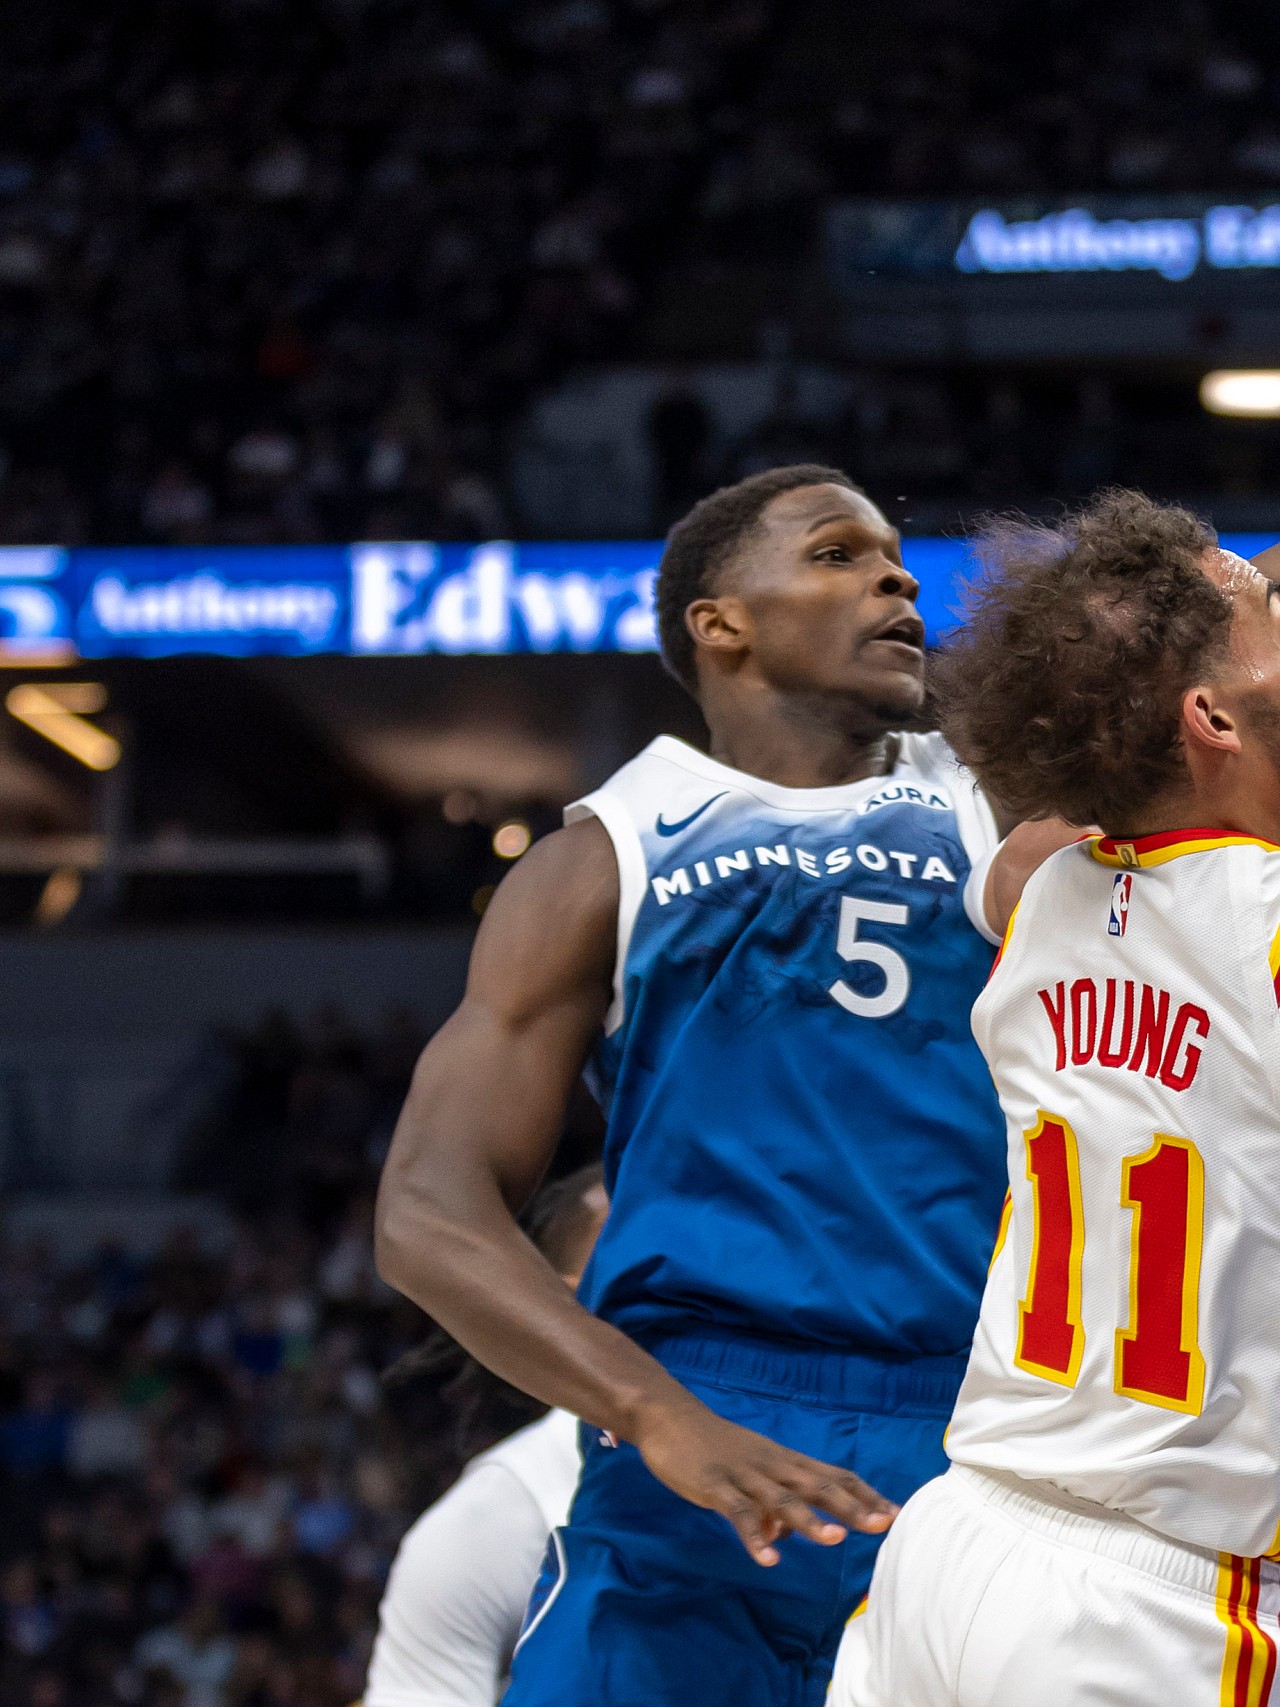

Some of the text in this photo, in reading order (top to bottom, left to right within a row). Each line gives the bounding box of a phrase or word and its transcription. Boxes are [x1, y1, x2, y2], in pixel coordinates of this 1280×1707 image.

[955, 208, 1198, 281] Anthony
[84, 570, 338, 652] Anthony
[864, 787, 949, 812] AURA
[651, 843, 957, 906] MINNESOTA
[827, 895, 911, 1020] 5
[1037, 977, 1211, 1093] YOUNG
[1013, 1108, 1207, 1417] 11
